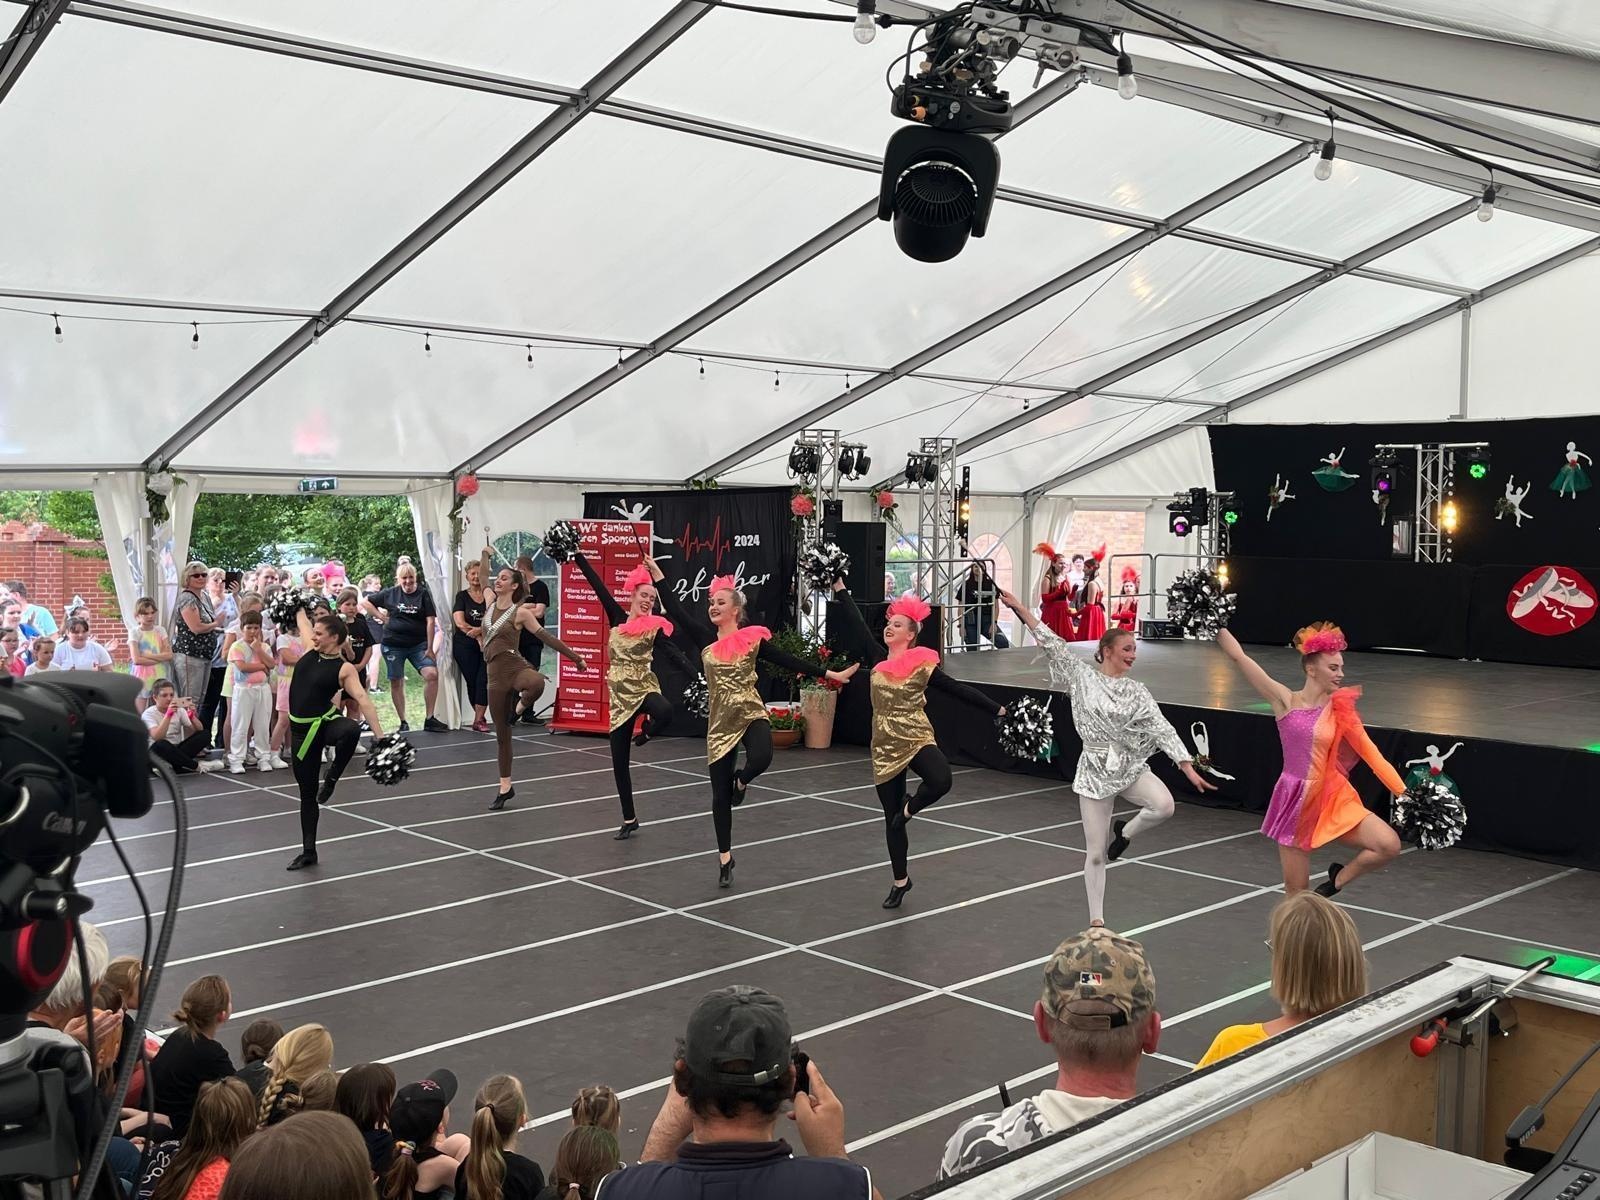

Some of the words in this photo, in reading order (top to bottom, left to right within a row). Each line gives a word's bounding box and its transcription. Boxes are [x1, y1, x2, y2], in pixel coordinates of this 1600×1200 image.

[579, 522, 598, 533] Wir
[602, 522, 634, 533] danken
[734, 534, 760, 547] 2024
[42, 811, 88, 835] Cann
